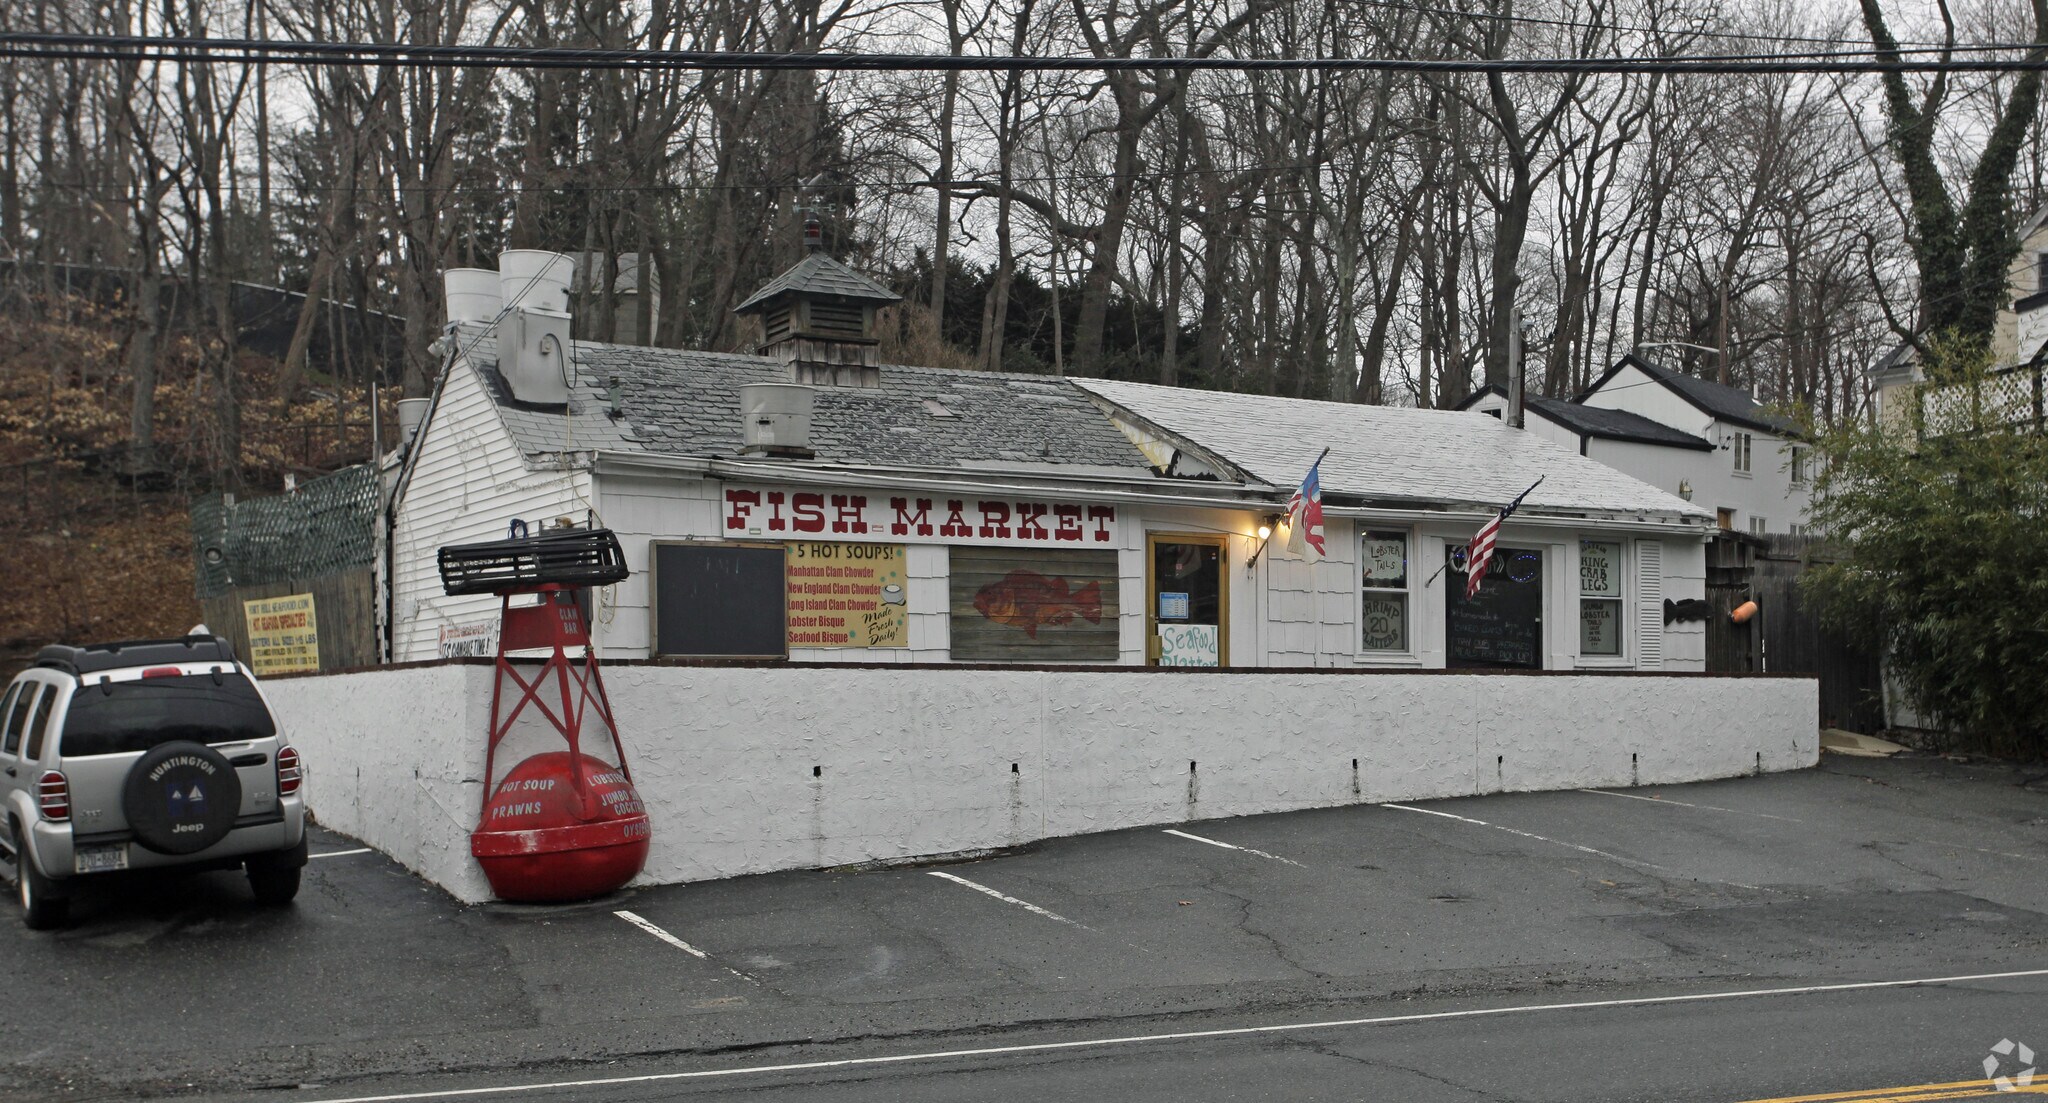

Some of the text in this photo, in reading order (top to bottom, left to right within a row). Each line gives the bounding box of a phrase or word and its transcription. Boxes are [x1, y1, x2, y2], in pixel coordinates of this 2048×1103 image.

[726, 489, 1115, 542] FISH MARKET
[798, 543, 894, 560] 5 HOT SOUPS!
[1370, 545, 1400, 558] LOBSTER
[1375, 560, 1396, 571] TAILS
[1581, 556, 1609, 568] KING
[788, 565, 874, 578] Manhattan Clam Chowder
[1580, 567, 1607, 580] CRAB
[788, 582, 881, 595] New England Clam Chowder
[1581, 579, 1609, 591] LEGS
[788, 599, 877, 611] Long Island Clam Chowder
[559, 607, 577, 620] CLAM
[861, 606, 892, 624] Made
[1580, 610, 1610, 619] LOBSTER
[788, 615, 845, 628] Lobster Bisque
[867, 618, 894, 635] Fresh
[1370, 617, 1388, 633] 20
[564, 622, 578, 635] BAR
[788, 631, 848, 644] Seafood Bisque
[868, 626, 898, 645] Daily!
[1162, 626, 1216, 654] Seafood
[150, 756, 216, 781] HUNTINGTON
[501, 779, 555, 793] HOT SOUP
[601, 790, 630, 806] JUMBO
[492, 801, 542, 820] PRAWNS
[172, 823, 204, 833] Jeep
